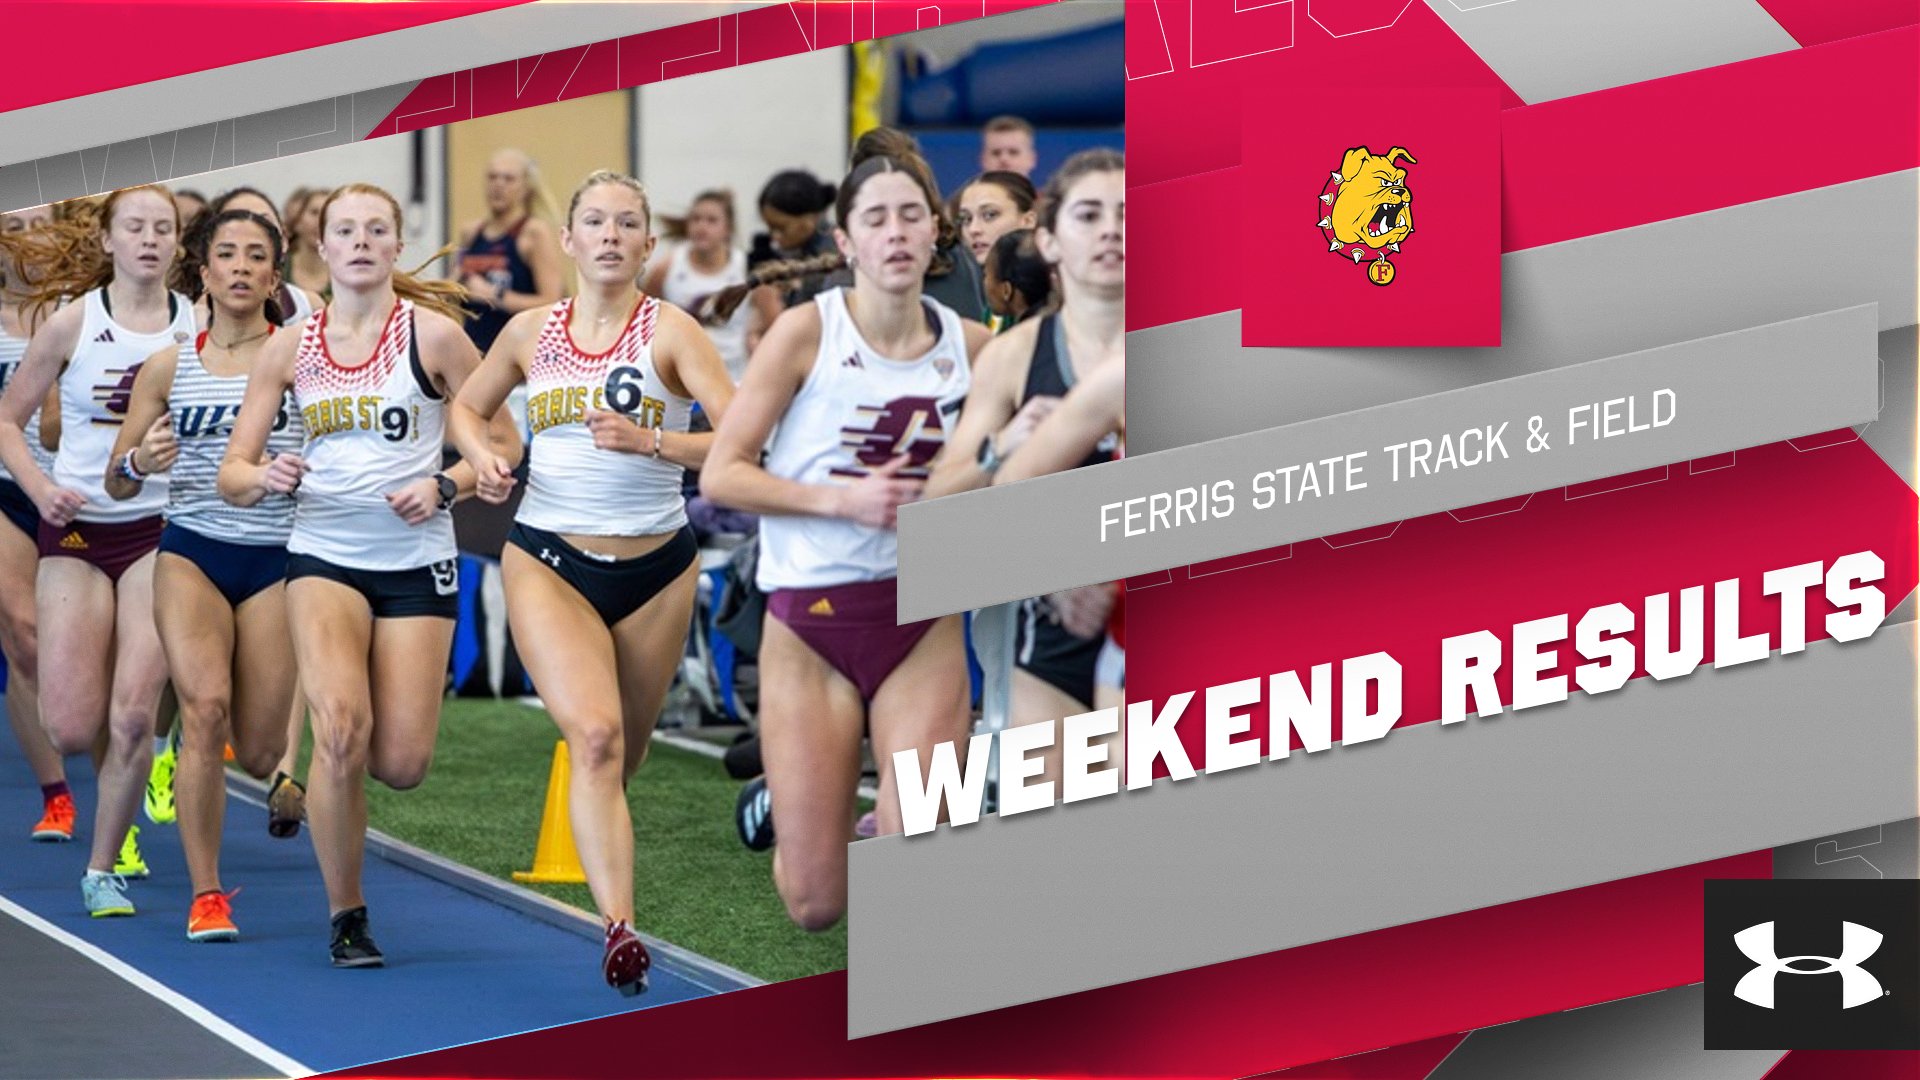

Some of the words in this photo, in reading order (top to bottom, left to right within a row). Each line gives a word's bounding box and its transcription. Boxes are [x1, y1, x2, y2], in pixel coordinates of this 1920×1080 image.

[527, 386, 588, 435] ERRIS
[605, 366, 644, 417] 6
[381, 406, 409, 442] 9
[432, 559, 456, 587] 9
